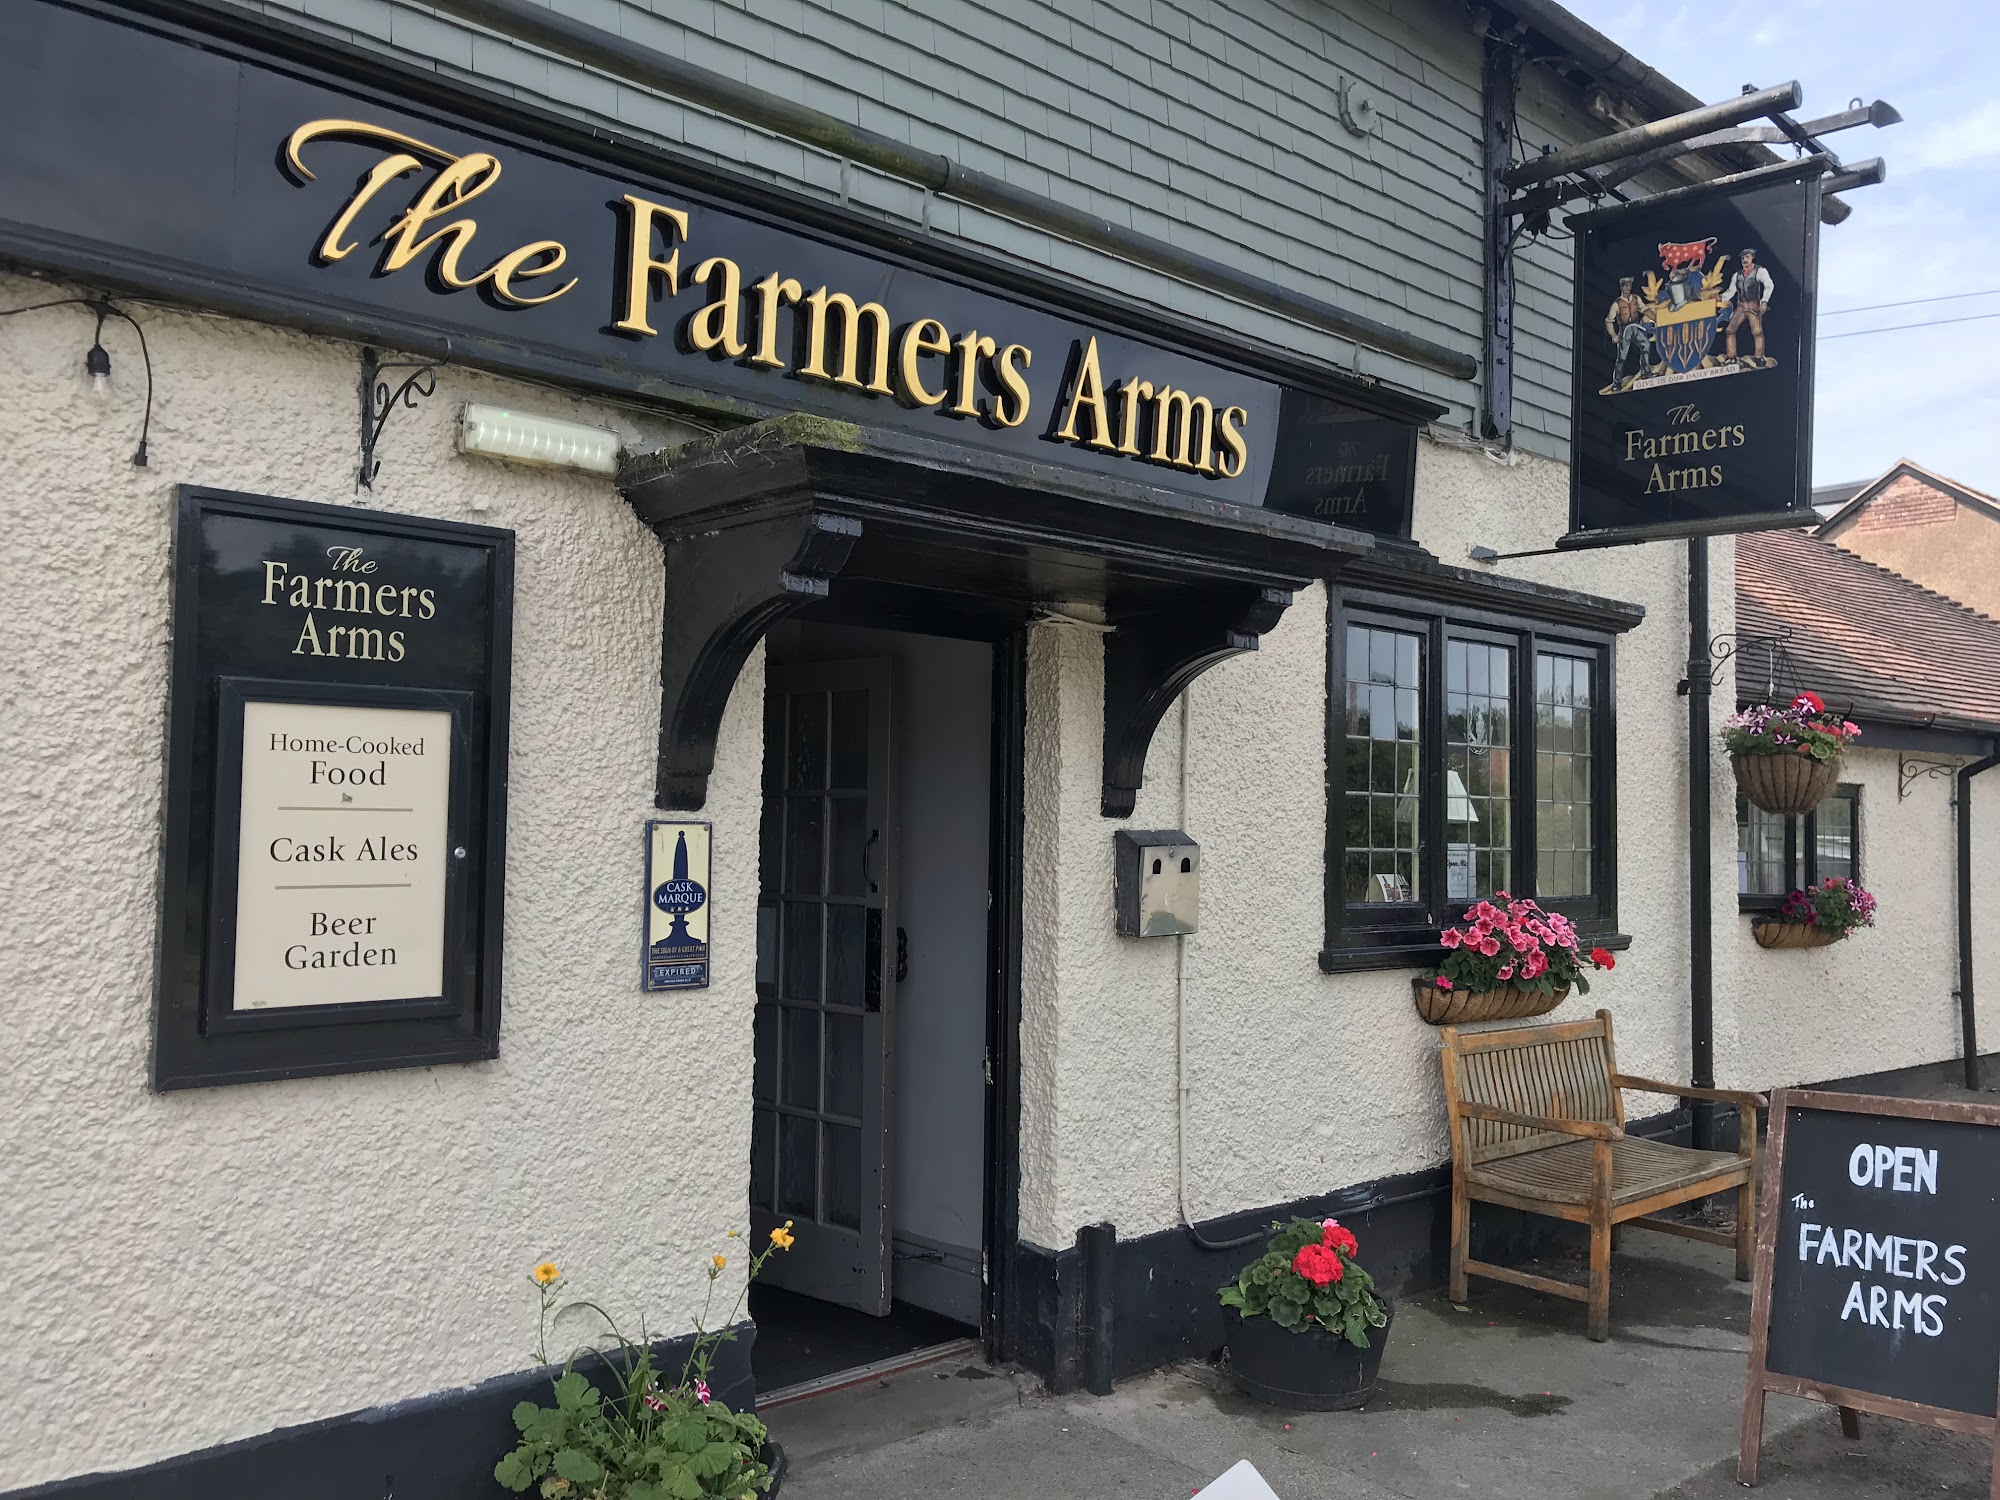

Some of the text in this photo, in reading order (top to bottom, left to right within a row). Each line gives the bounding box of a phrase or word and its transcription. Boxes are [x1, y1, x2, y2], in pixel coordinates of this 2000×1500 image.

[286, 119, 1248, 479] The Farmers Arms
[1636, 380, 1655, 389] GIVE
[1668, 375, 1684, 383] OUR
[1686, 370, 1708, 380] DAILY
[1709, 366, 1736, 376] BREAD
[1666, 403, 1701, 426] The
[1624, 423, 1745, 461] Farmers
[1644, 462, 1723, 494] Arms
[326, 545, 379, 574] The
[260, 560, 436, 620] Farmers
[291, 611, 407, 663] Arms
[269, 732, 425, 757] Home-Cooked
[309, 759, 387, 787] Food
[269, 835, 419, 863] Cask Ales
[657, 893, 703, 905] MARQUE
[666, 882, 694, 893] CASK
[309, 912, 377, 937] Beer
[284, 940, 398, 970] Garden
[651, 947, 660, 955] THE
[660, 946, 671, 954] SIGN
[682, 945, 695, 953] GREAT
[659, 967, 696, 977] EXPIRED
[1848, 1143, 1938, 1195] OPEN
[1791, 1192, 1815, 1210] The
[1798, 1222, 1967, 1286] FARMERS
[1840, 1281, 1948, 1337] ARMS
